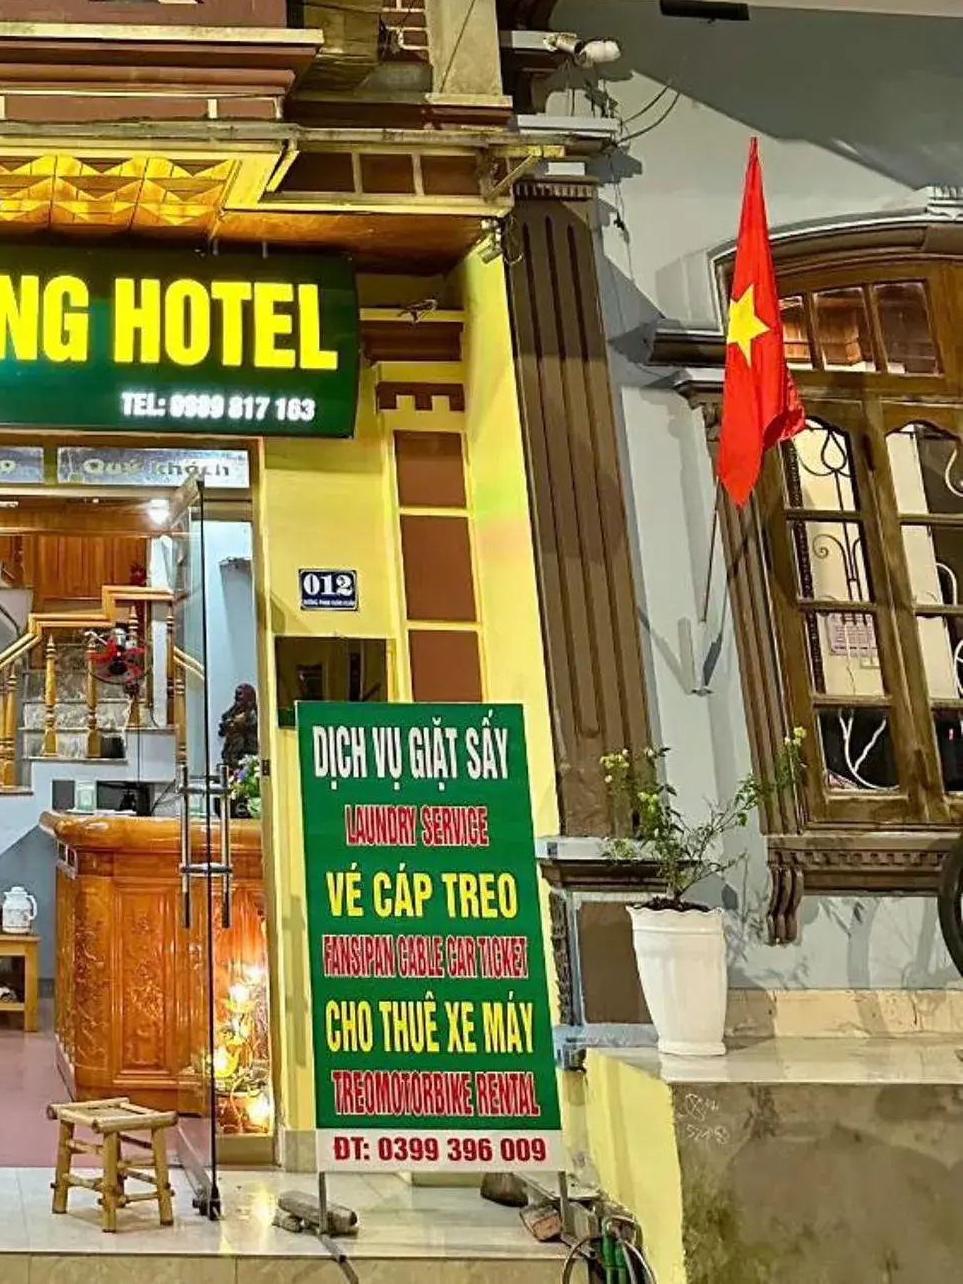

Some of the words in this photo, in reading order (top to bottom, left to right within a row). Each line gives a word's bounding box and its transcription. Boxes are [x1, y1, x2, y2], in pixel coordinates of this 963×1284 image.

[114, 278, 338, 370] HOTEL
[121, 391, 166, 417] TEL:
[228, 396, 270, 420] 817
[303, 573, 353, 596] 012
[312, 725, 368, 790] DỊCH
[372, 727, 402, 791] VỤ
[408, 716, 457, 791] GIẶT
[465, 709, 508, 779] SẤY
[345, 804, 417, 846] LAUNDRY
[420, 804, 489, 847] SERVICE
[325, 863, 362, 917] VÉ
[373, 863, 433, 918] CÁP
[441, 872, 519, 919] TREO
[322, 934, 396, 978] FANSIPAN
[397, 934, 445, 978] CABLE
[446, 935, 478, 979] CAR
[477, 936, 529, 979] TICKET
[325, 1000, 373, 1053] CHO
[379, 991, 440, 1053] THUÊ
[445, 1001, 477, 1054] XE
[482, 991, 534, 1054] MÁY
[332, 1070, 474, 1117] TREOMOTORBIKE
[475, 1071, 541, 1117] RENTAL
[333, 1136, 370, 1161] ĐT:
[378, 1137, 439, 1162] 0399
[447, 1138, 493, 1162] 396
[500, 1138, 547, 1162] 009
